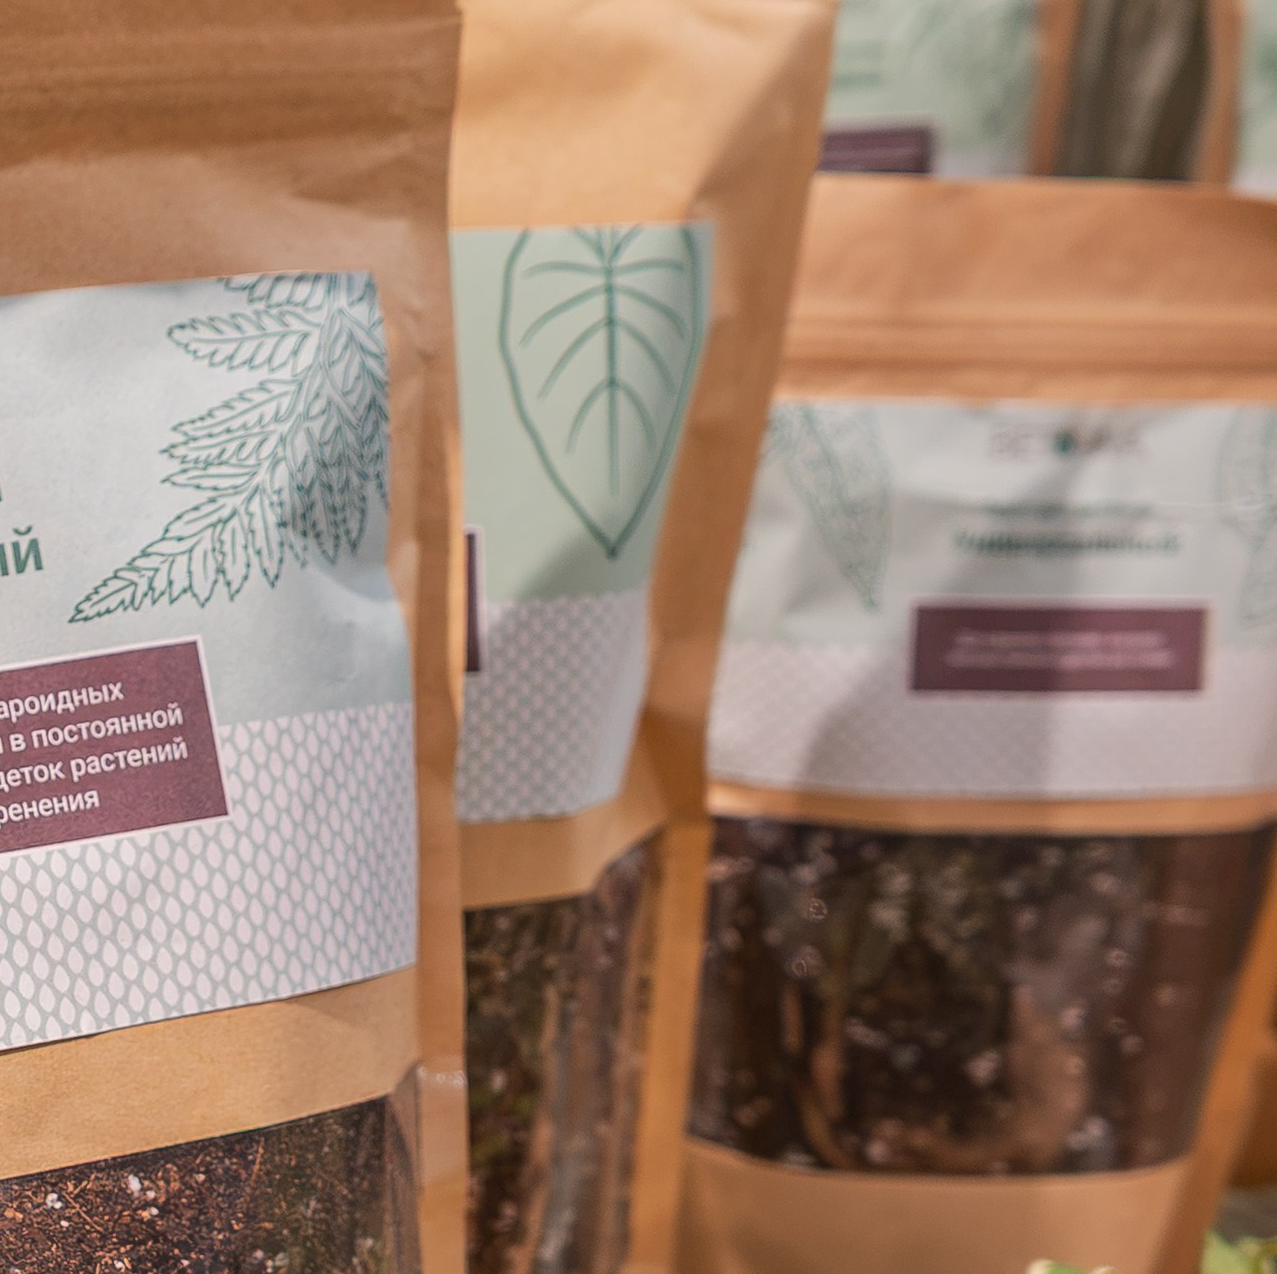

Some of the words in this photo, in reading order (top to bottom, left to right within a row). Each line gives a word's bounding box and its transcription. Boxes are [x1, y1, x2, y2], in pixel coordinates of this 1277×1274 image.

[10, 734, 26, 752] в
[32, 703, 183, 749] постоянной
[72, 738, 188, 779] растений
